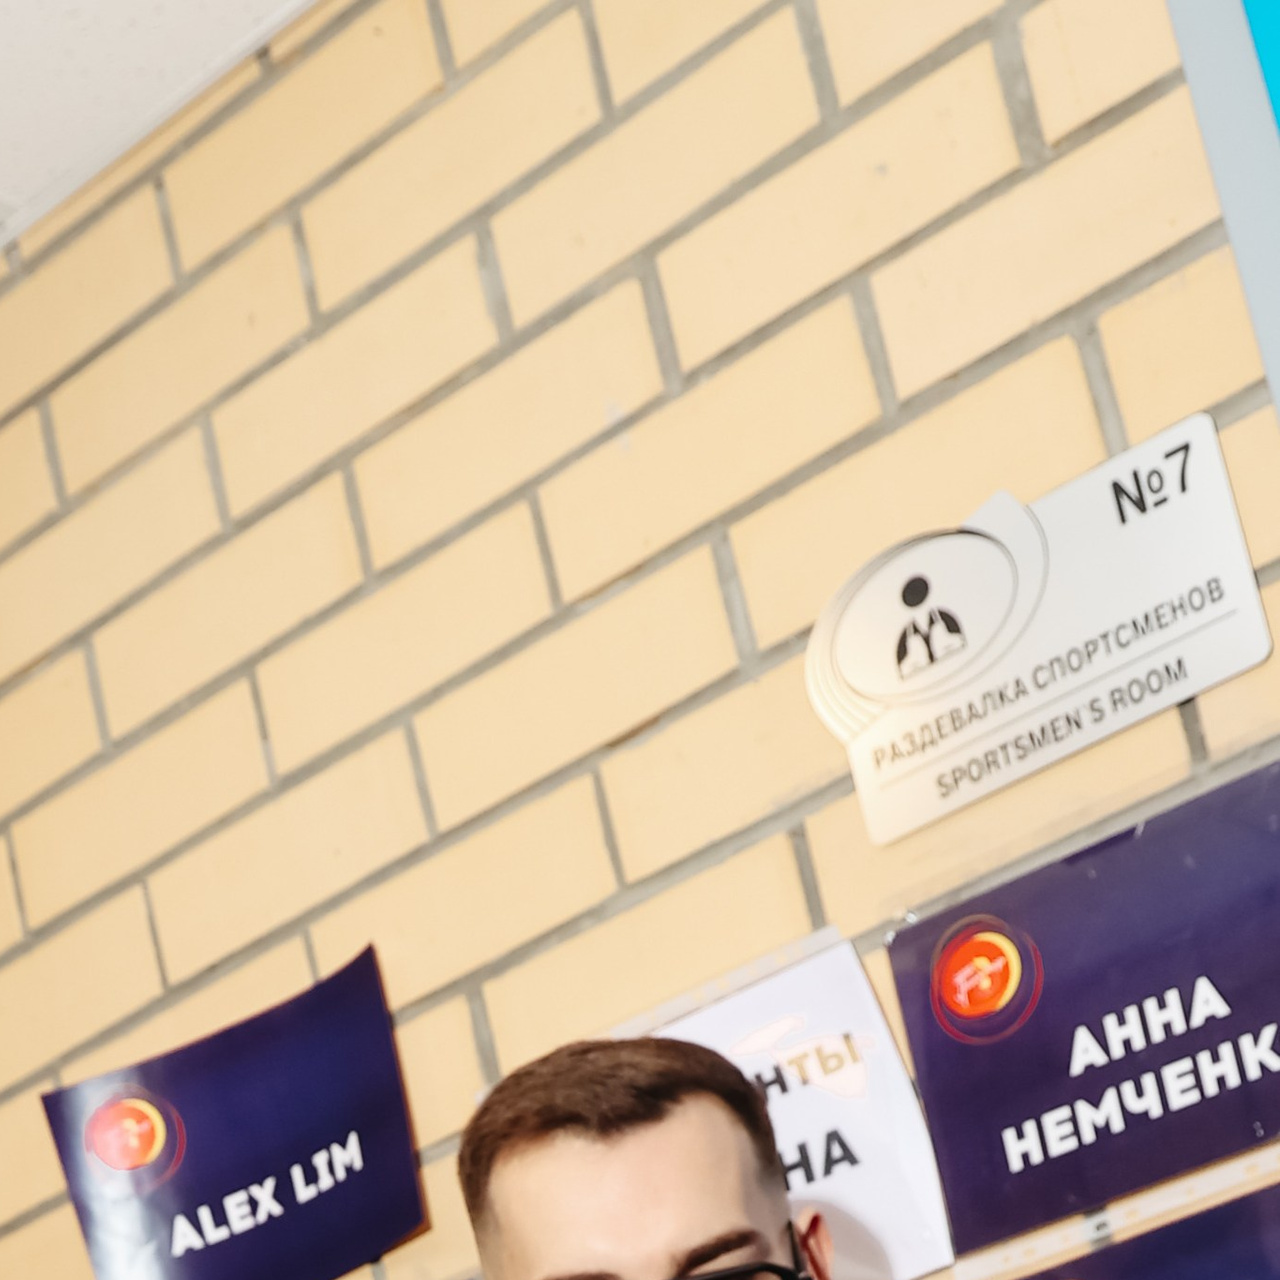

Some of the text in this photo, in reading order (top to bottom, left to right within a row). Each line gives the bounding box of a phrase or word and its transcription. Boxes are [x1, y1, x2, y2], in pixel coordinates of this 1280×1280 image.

[873, 576, 1225, 769] РАЗДЕВАЛКА СПОРТСМЕНОВ
[1109, 657, 1188, 712] ROOM
[1069, 975, 1232, 1078] АННА
[1001, 1022, 1280, 1174] НЕМЧЕНК
[171, 1130, 364, 1258] ALEX LIM
[778, 1129, 860, 1191] НА
